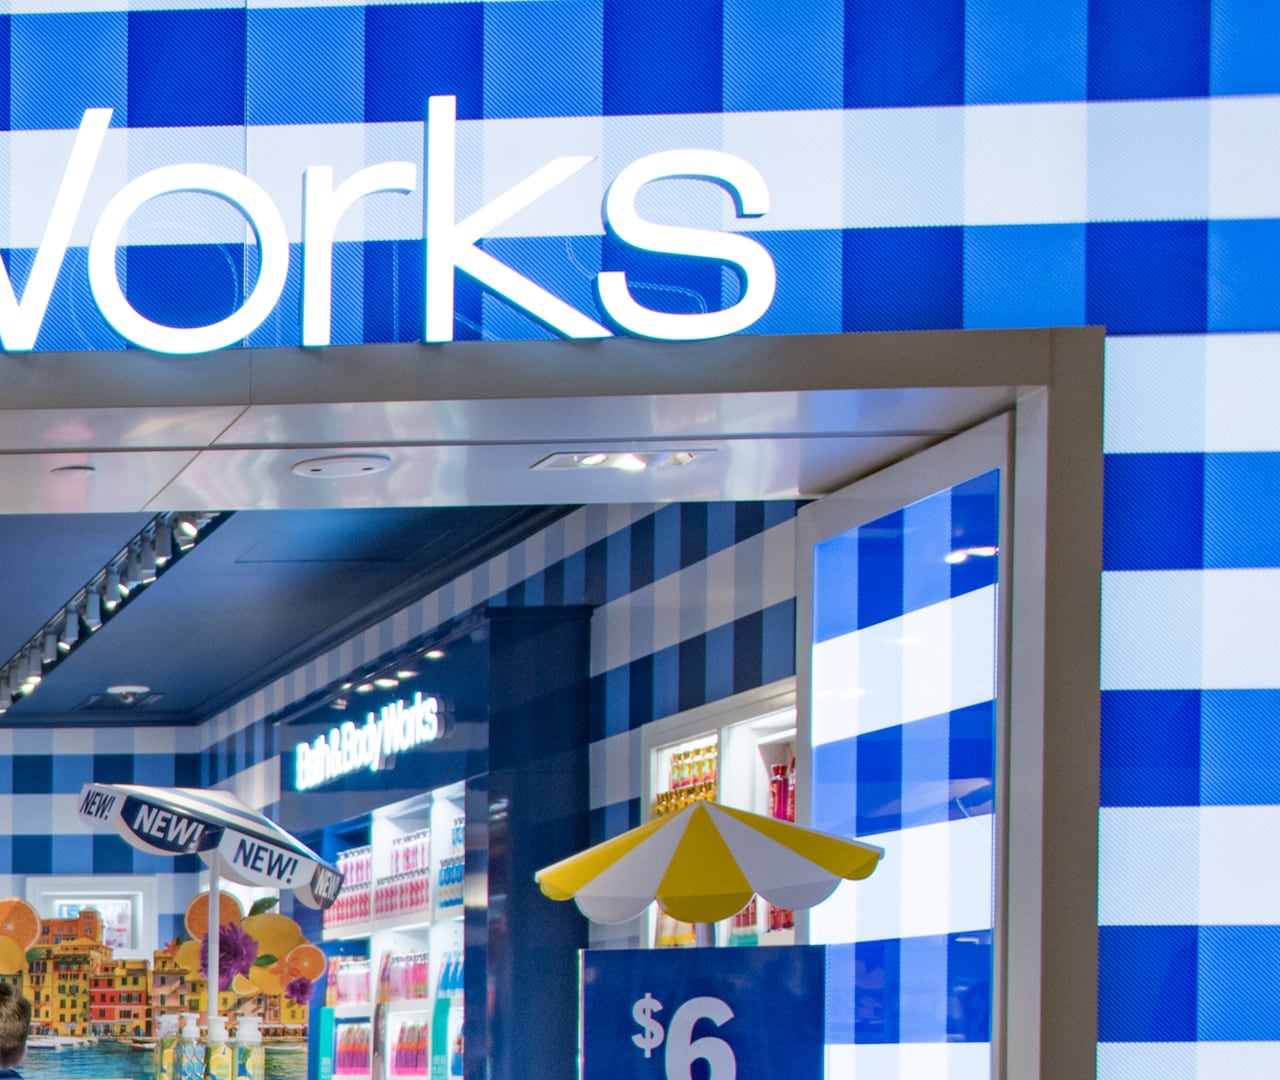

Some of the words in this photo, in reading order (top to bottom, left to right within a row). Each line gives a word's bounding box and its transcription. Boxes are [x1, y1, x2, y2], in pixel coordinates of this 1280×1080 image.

[340, 711, 383, 773] Body
[380, 690, 439, 756] Works
[80, 788, 117, 821] NEW!
[132, 803, 206, 849] NEW!
[232, 837, 300, 885] NEW!
